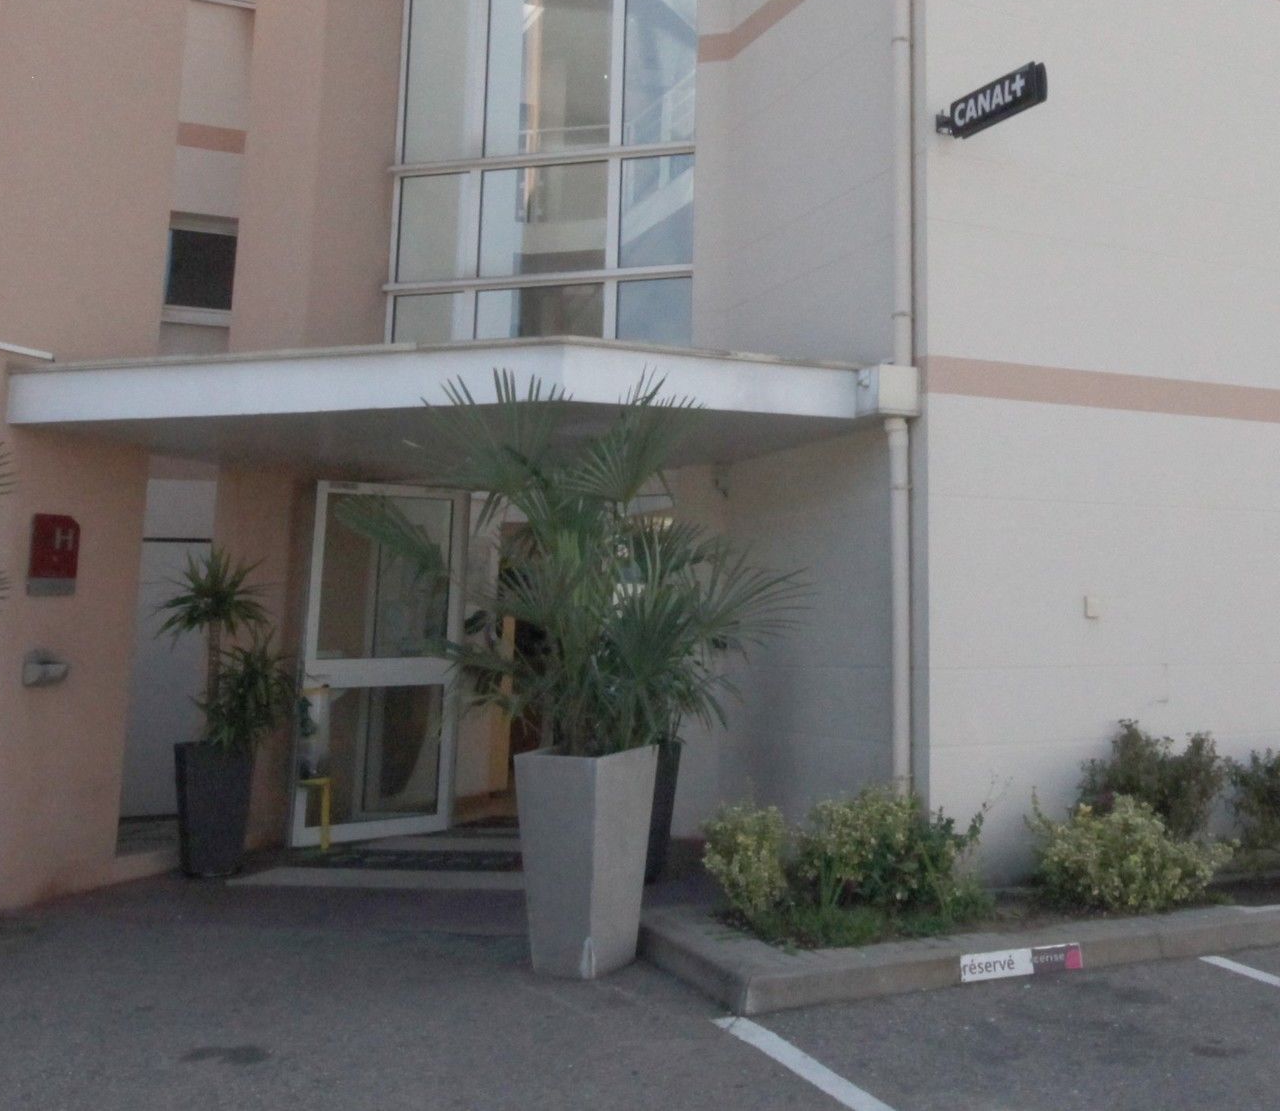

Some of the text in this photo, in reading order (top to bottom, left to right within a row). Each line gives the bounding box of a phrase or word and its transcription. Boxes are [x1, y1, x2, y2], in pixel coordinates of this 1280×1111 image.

[954, 73, 1026, 127] CANAL+
[54, 525, 74, 551] H
[962, 954, 1016, 976] réservé
